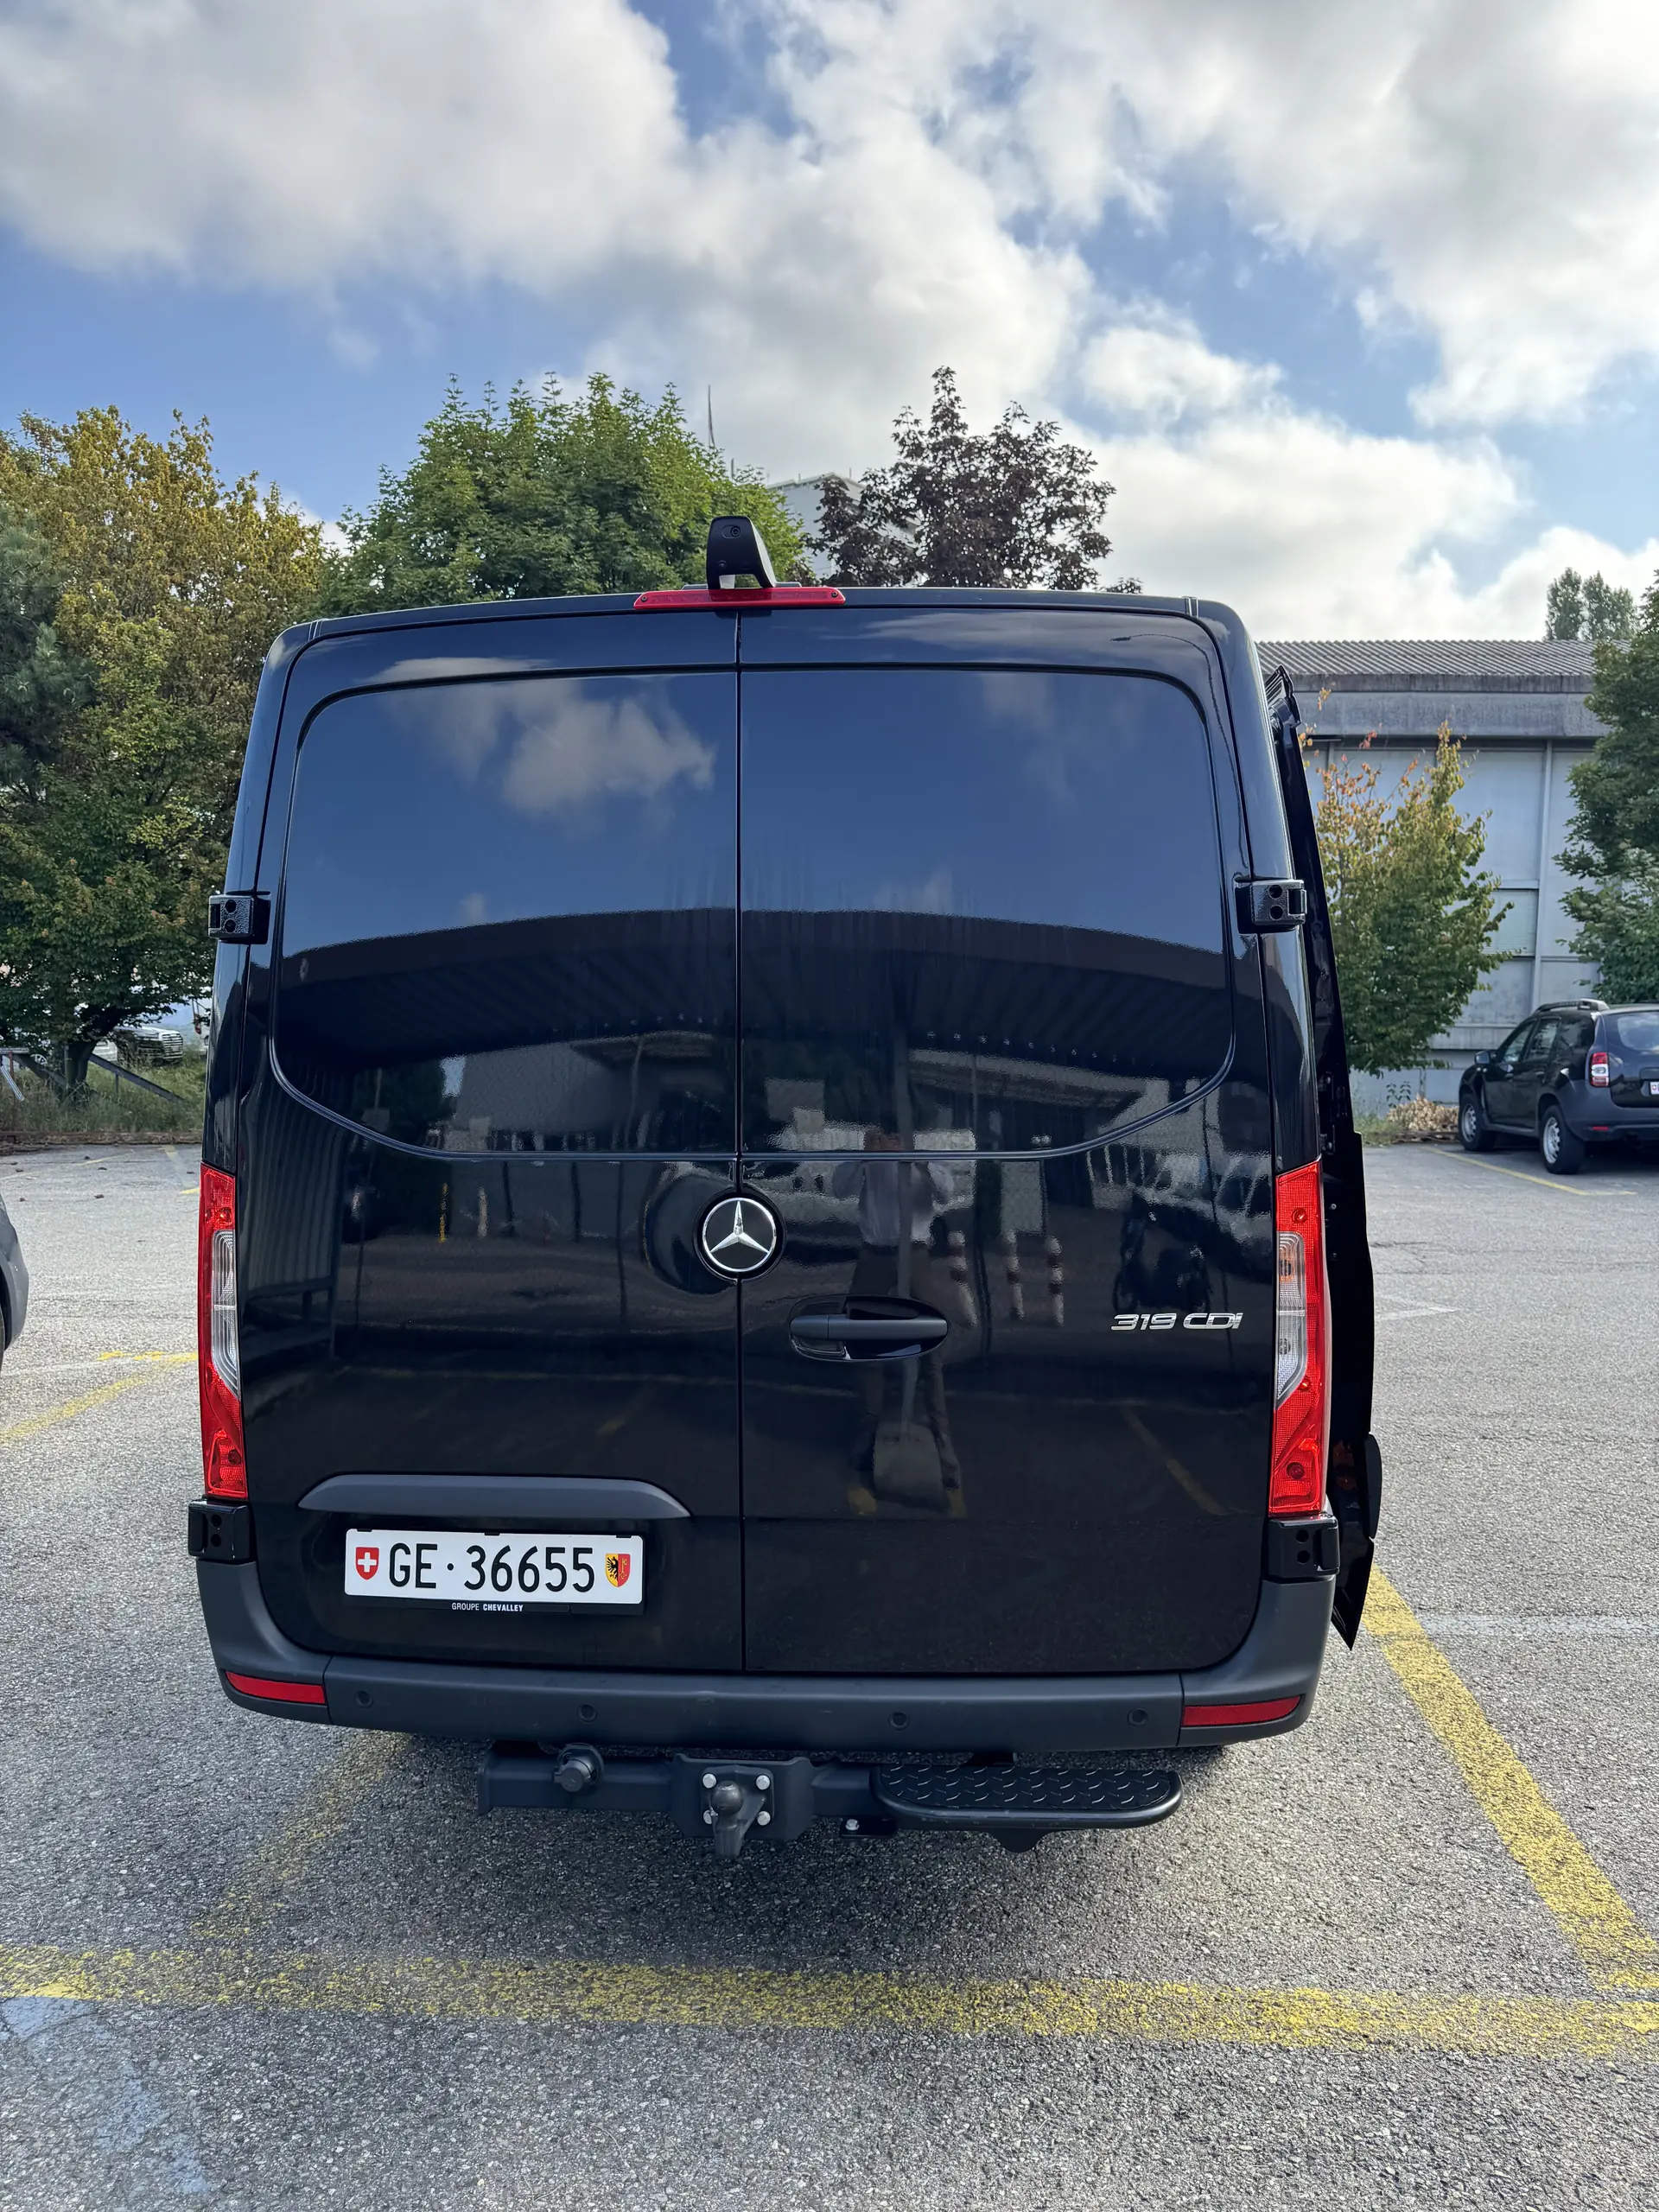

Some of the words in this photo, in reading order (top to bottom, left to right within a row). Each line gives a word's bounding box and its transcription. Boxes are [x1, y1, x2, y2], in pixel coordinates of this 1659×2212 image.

[1110, 1313, 1177, 1331] 319
[1183, 1313, 1243, 1330] CDI
[451, 1602, 480, 1611] GROUPE
[482, 1603, 524, 1612] CHEVALLEY
